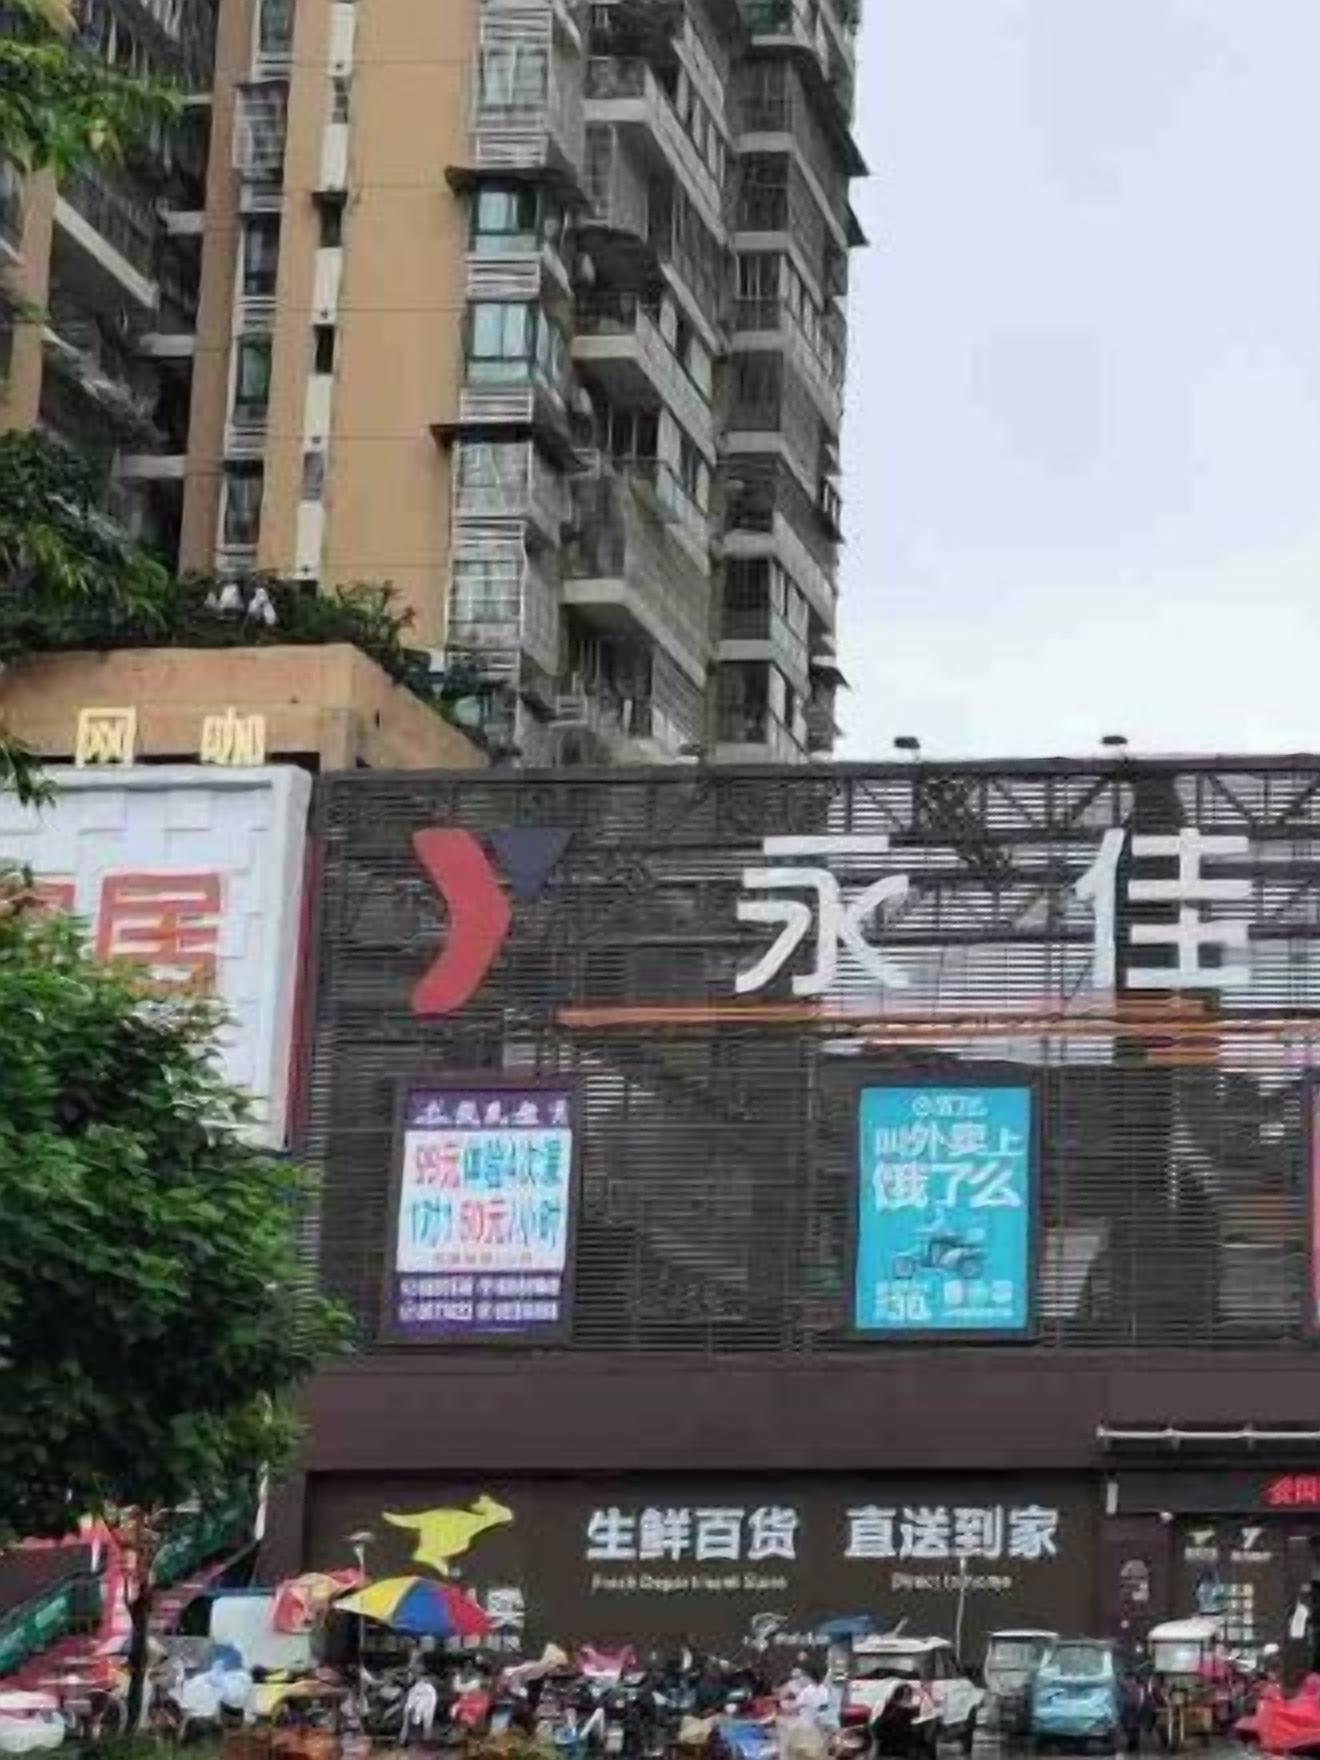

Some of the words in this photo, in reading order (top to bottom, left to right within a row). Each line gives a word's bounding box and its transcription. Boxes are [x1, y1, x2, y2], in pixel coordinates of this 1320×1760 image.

[872, 1161, 1022, 1213] 饿了么
[586, 1505, 798, 1561] 生鲜百货
[844, 1504, 1058, 1559] 直送到家
